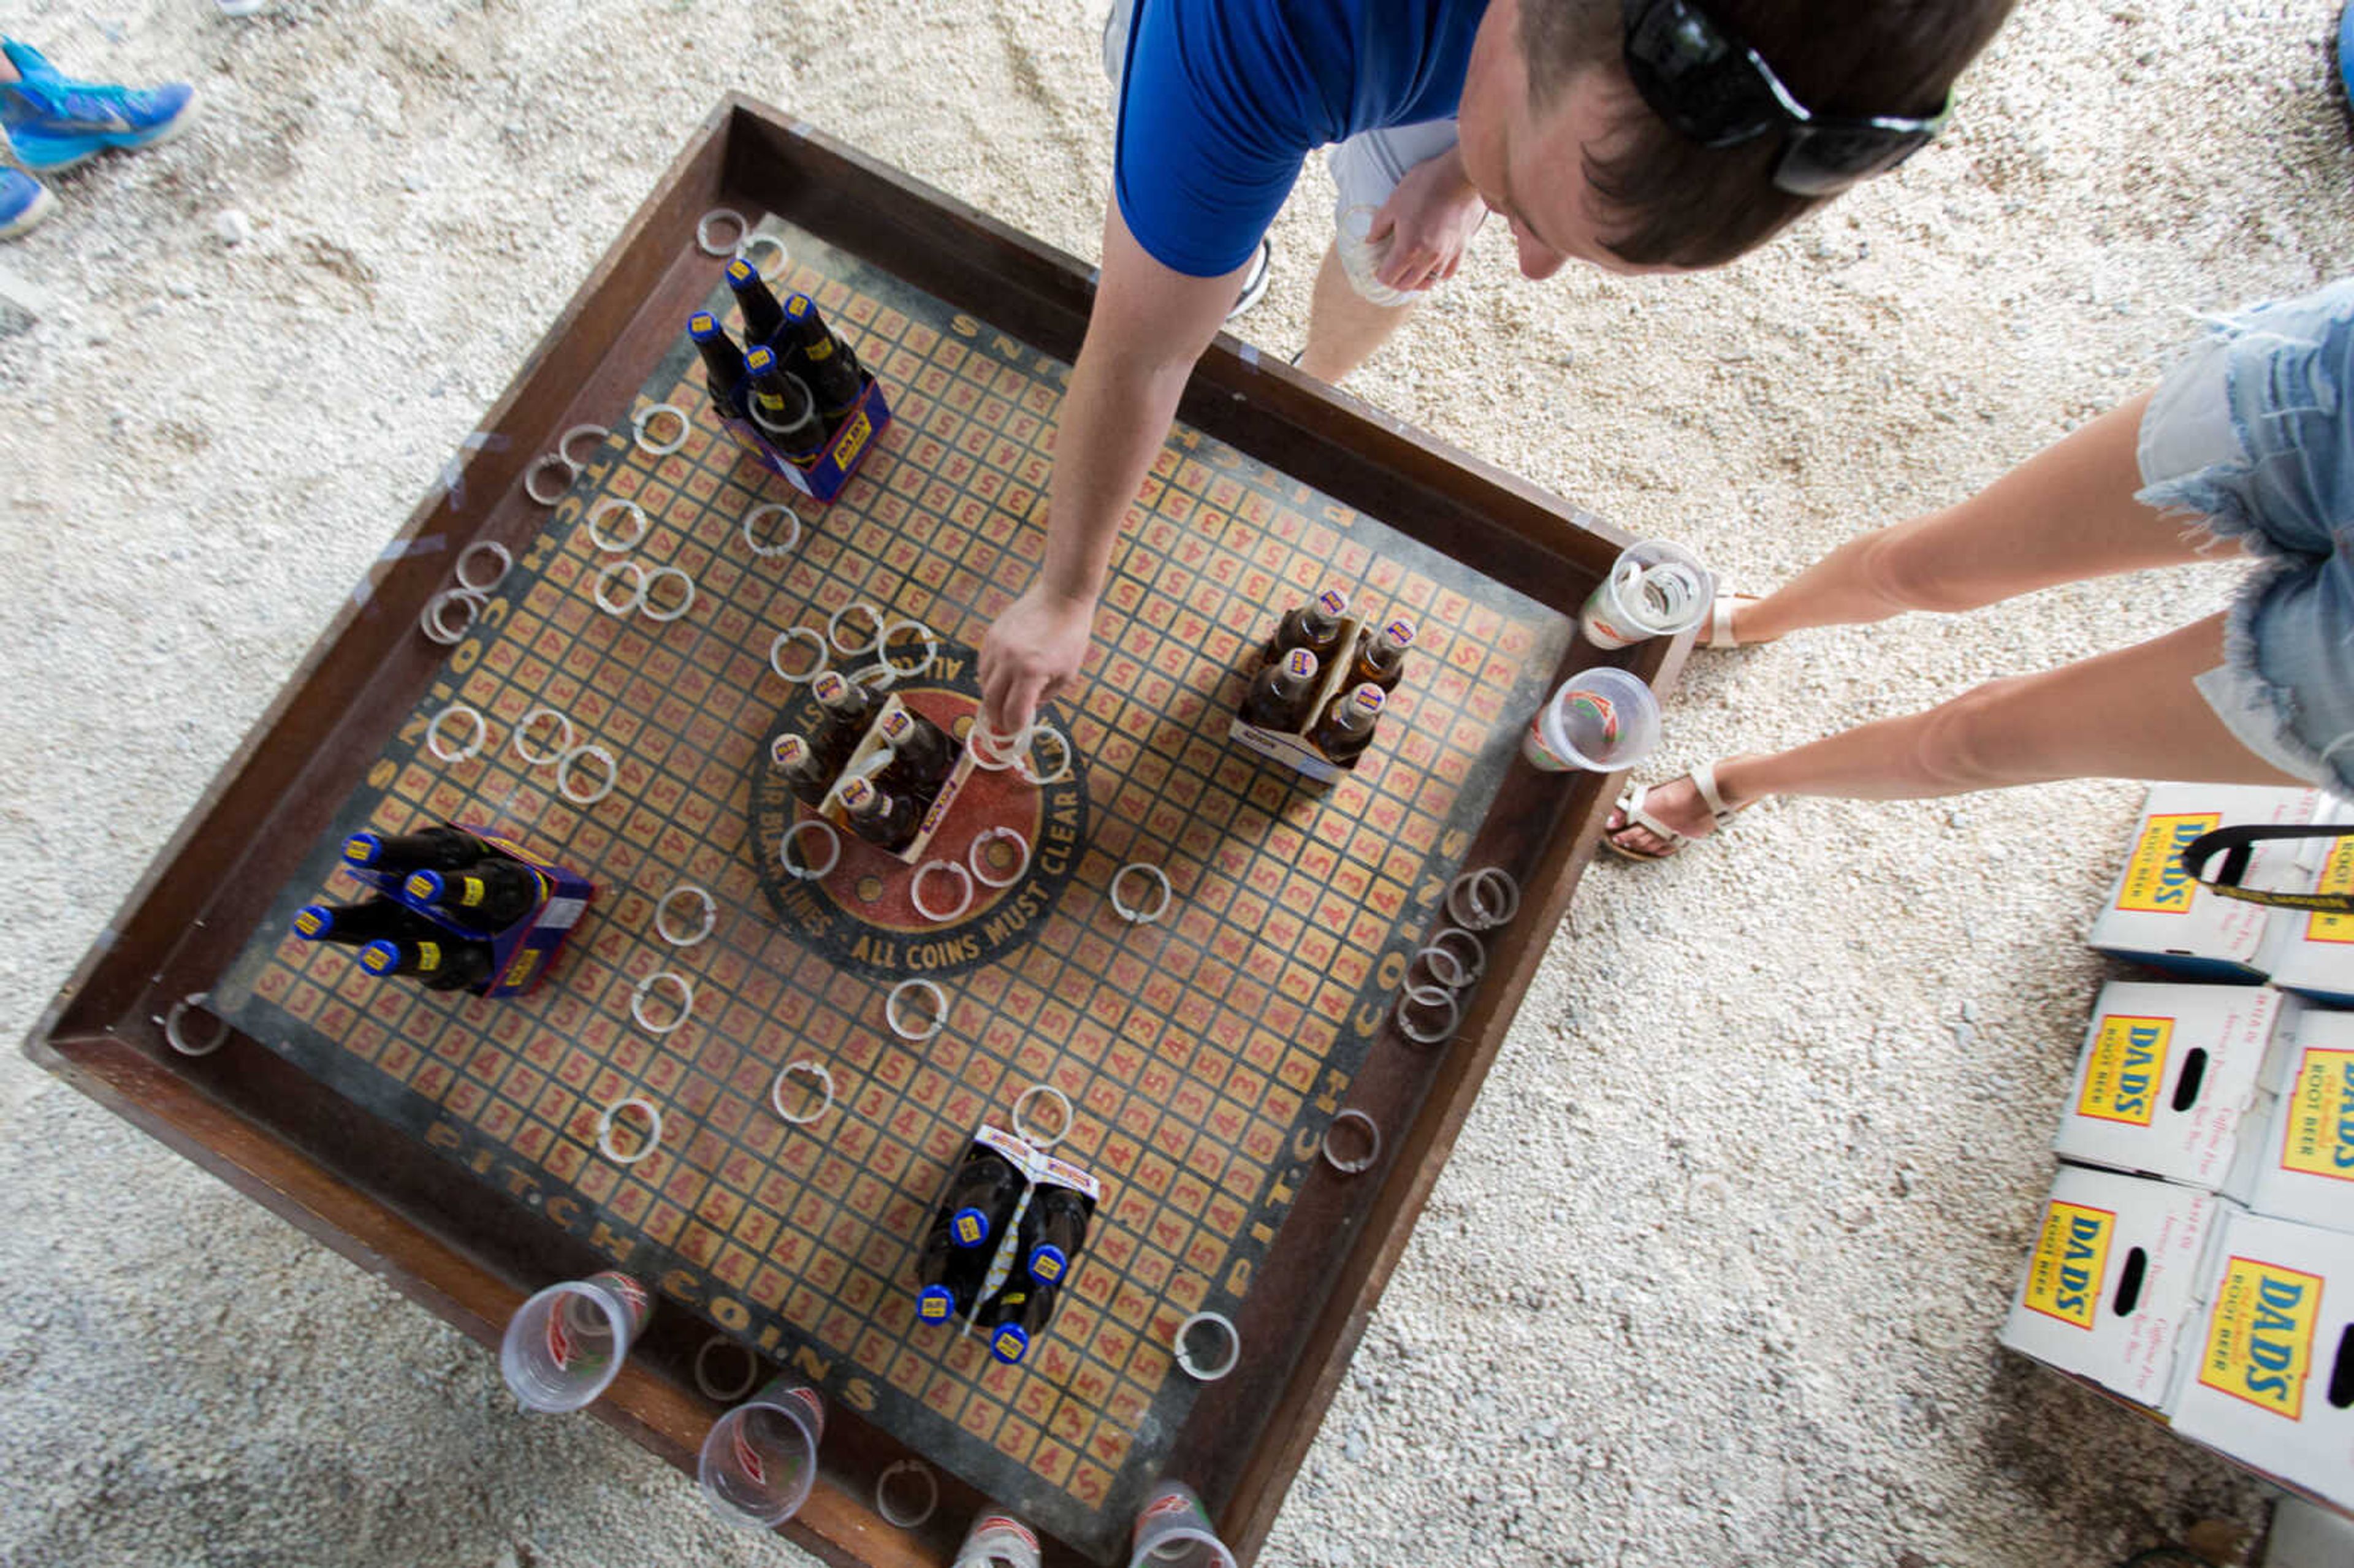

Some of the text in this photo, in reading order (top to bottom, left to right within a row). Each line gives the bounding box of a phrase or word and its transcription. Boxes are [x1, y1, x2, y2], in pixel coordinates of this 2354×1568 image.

[926, 370, 946, 393] 3
[940, 345, 961, 367] 5
[983, 403, 1004, 423] 5
[1033, 389, 1055, 410] 5
[936, 414, 1044, 481] 5 3 5
[919, 443, 1029, 511] 3 5 4 3
[932, 484, 981, 527] 3 5
[1118, 509, 1173, 549] 3 5
[1169, 496, 1253, 550] 4 3 5
[1215, 558, 1268, 598] 3 5
[1265, 545, 1283, 568] 5
[539, 631, 563, 654] 4
[1117, 584, 1234, 658] 5 4 3 5
[522, 661, 547, 682] 5
[1454, 645, 1481, 665] 5
[368, 597, 509, 789] COINS
[577, 693, 602, 716] 4
[851, 935, 896, 969] ALL
[906, 934, 980, 970] COINS
[984, 879, 1049, 946] MUST
[1040, 791, 1080, 875] CLEAR
[1233, 834, 1296, 924] 3 5 4
[1286, 851, 1331, 907] 3 5
[1372, 889, 1399, 913] 4
[1387, 855, 1415, 879] 3
[1285, 837, 1381, 995] 3 5 4 3 5
[574, 964, 603, 994] 5
[628, 948, 655, 976] 5
[1319, 993, 1347, 1019] 4
[440, 1029, 598, 1138] 3 4 5 3 4
[530, 1035, 589, 1083] 4 5
[880, 1053, 905, 1082] 5
[1176, 1054, 1224, 1115] 3 5
[1227, 828, 1469, 1298] PITCH COINS
[2115, 1026, 2160, 1116] DAD'S
[2306, 1064, 2326, 1109] ROOT
[383, 1044, 411, 1079] 3
[416, 1065, 443, 1092] 4
[448, 1083, 481, 1111] 5
[484, 1103, 511, 1133] 3
[515, 1126, 543, 1154] 4
[547, 1145, 576, 1176] 5
[859, 1089, 918, 1135] 3 4
[1106, 1036, 1190, 1168] 4 3 5 4
[1231, 1075, 1259, 1100] 3
[873, 1143, 901, 1174] 5
[2299, 1114, 2319, 1157] BEER
[1156, 1147, 1221, 1249] 4 3 5
[1171, 1060, 1311, 1300] 3 5 4 3 5 4 3
[647, 1205, 677, 1237] 5
[703, 1191, 799, 1265] 5 3 4
[425, 1121, 879, 1410] PITCH COINS
[1062, 1311, 1090, 1336] 3
[1102, 1237, 1130, 1263] 4
[1120, 1198, 1148, 1225] 3
[1138, 1163, 1166, 1188] 5
[2055, 1215, 2102, 1319] DAD'S
[715, 1250, 813, 1321] 4 5 3
[2211, 1274, 2244, 1372] ROOT BEER
[2245, 1274, 2304, 1402] DAD'S
[1132, 1353, 1161, 1383] 5
[1019, 1385, 1083, 1441] 5 3
[965, 1400, 991, 1433] 5
[996, 1422, 1026, 1455] 3
[1035, 1446, 1060, 1475] 4
[1076, 1467, 1101, 1502] 5
[1093, 1434, 1122, 1461] 4
